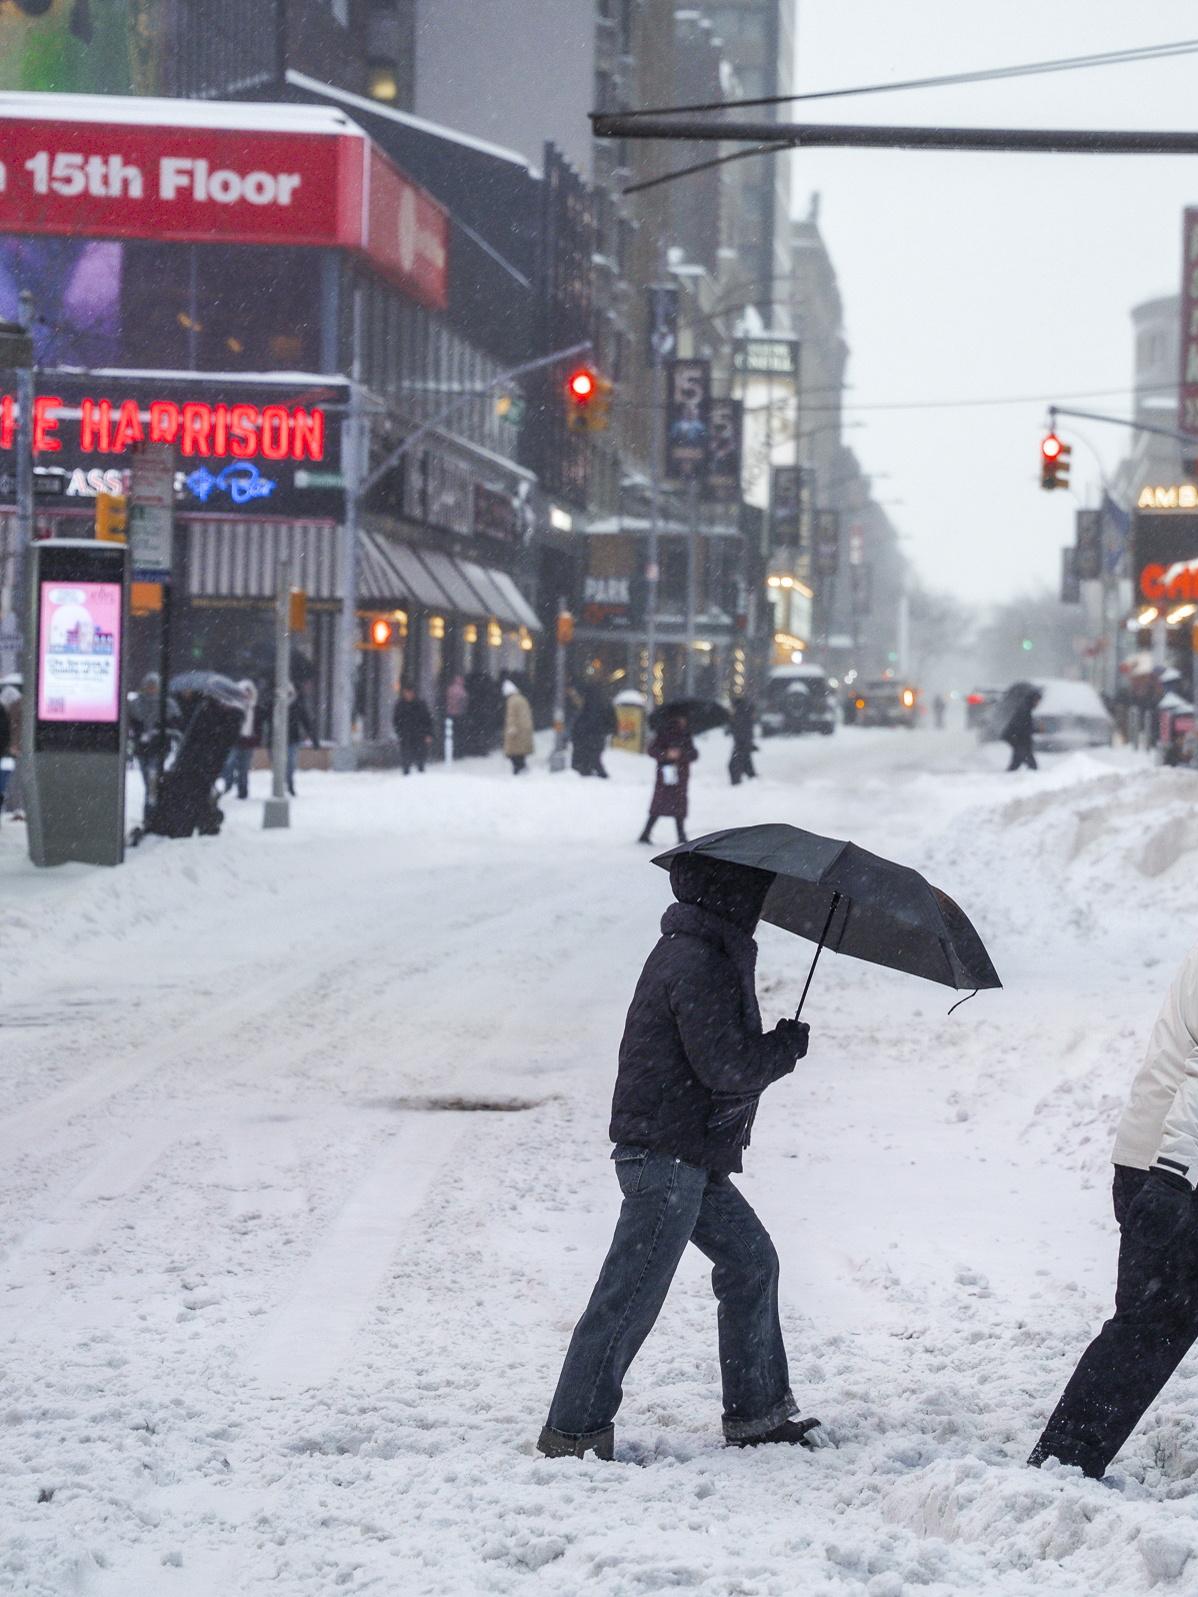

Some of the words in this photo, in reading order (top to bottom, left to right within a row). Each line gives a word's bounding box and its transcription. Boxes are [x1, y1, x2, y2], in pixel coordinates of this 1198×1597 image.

[25, 151, 144, 199] 15th
[159, 156, 300, 206] Floor
[81, 398, 324, 461] HARRISON
